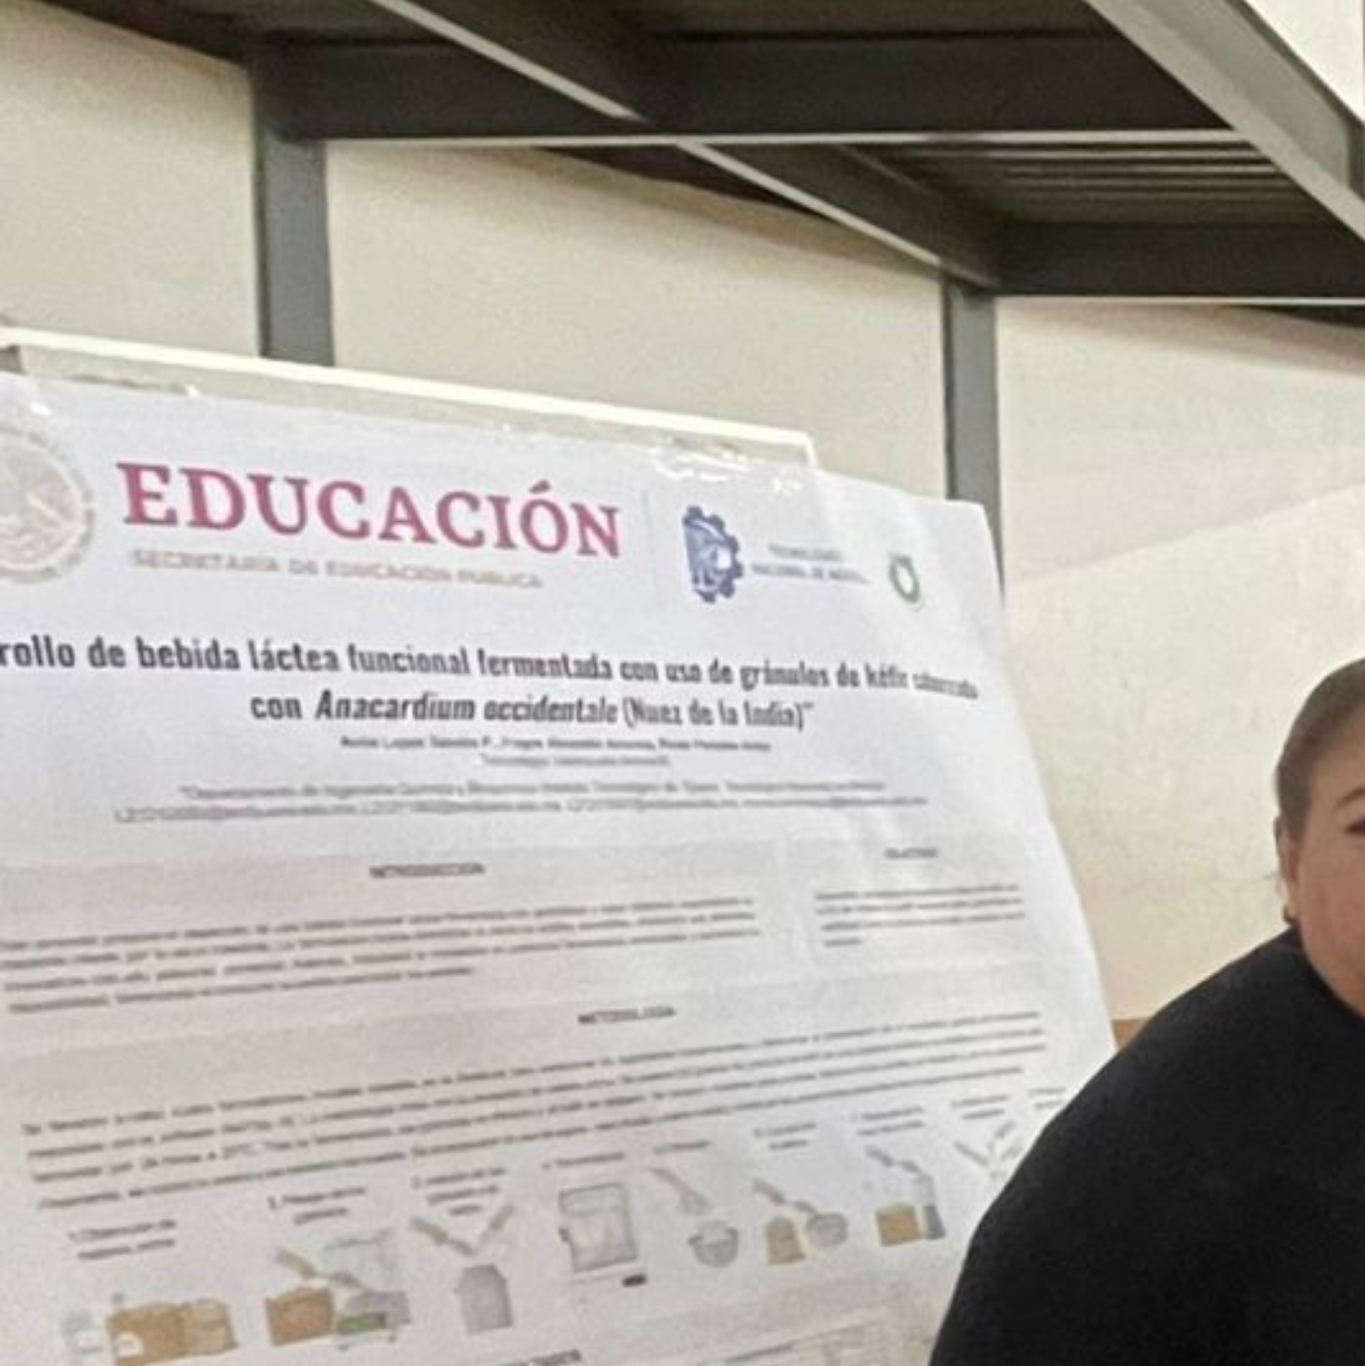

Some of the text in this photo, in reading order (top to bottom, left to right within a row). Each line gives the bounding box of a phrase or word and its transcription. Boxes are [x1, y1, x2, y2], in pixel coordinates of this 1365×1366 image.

[116, 461, 620, 558] EDUCACIÓN
[88, 636, 126, 668] de
[135, 636, 241, 669] bebida
[248, 637, 341, 672] láctea
[348, 643, 471, 676] funcional
[477, 648, 613, 680] fermentada
[620, 661, 659, 682] con
[665, 663, 702, 684] uso
[708, 658, 733, 684] de
[836, 661, 860, 687] de
[250, 695, 303, 721] con
[315, 688, 476, 722] Anacardium
[484, 694, 618, 724] occidentale
[689, 698, 714, 726] de
[718, 698, 739, 726] la
